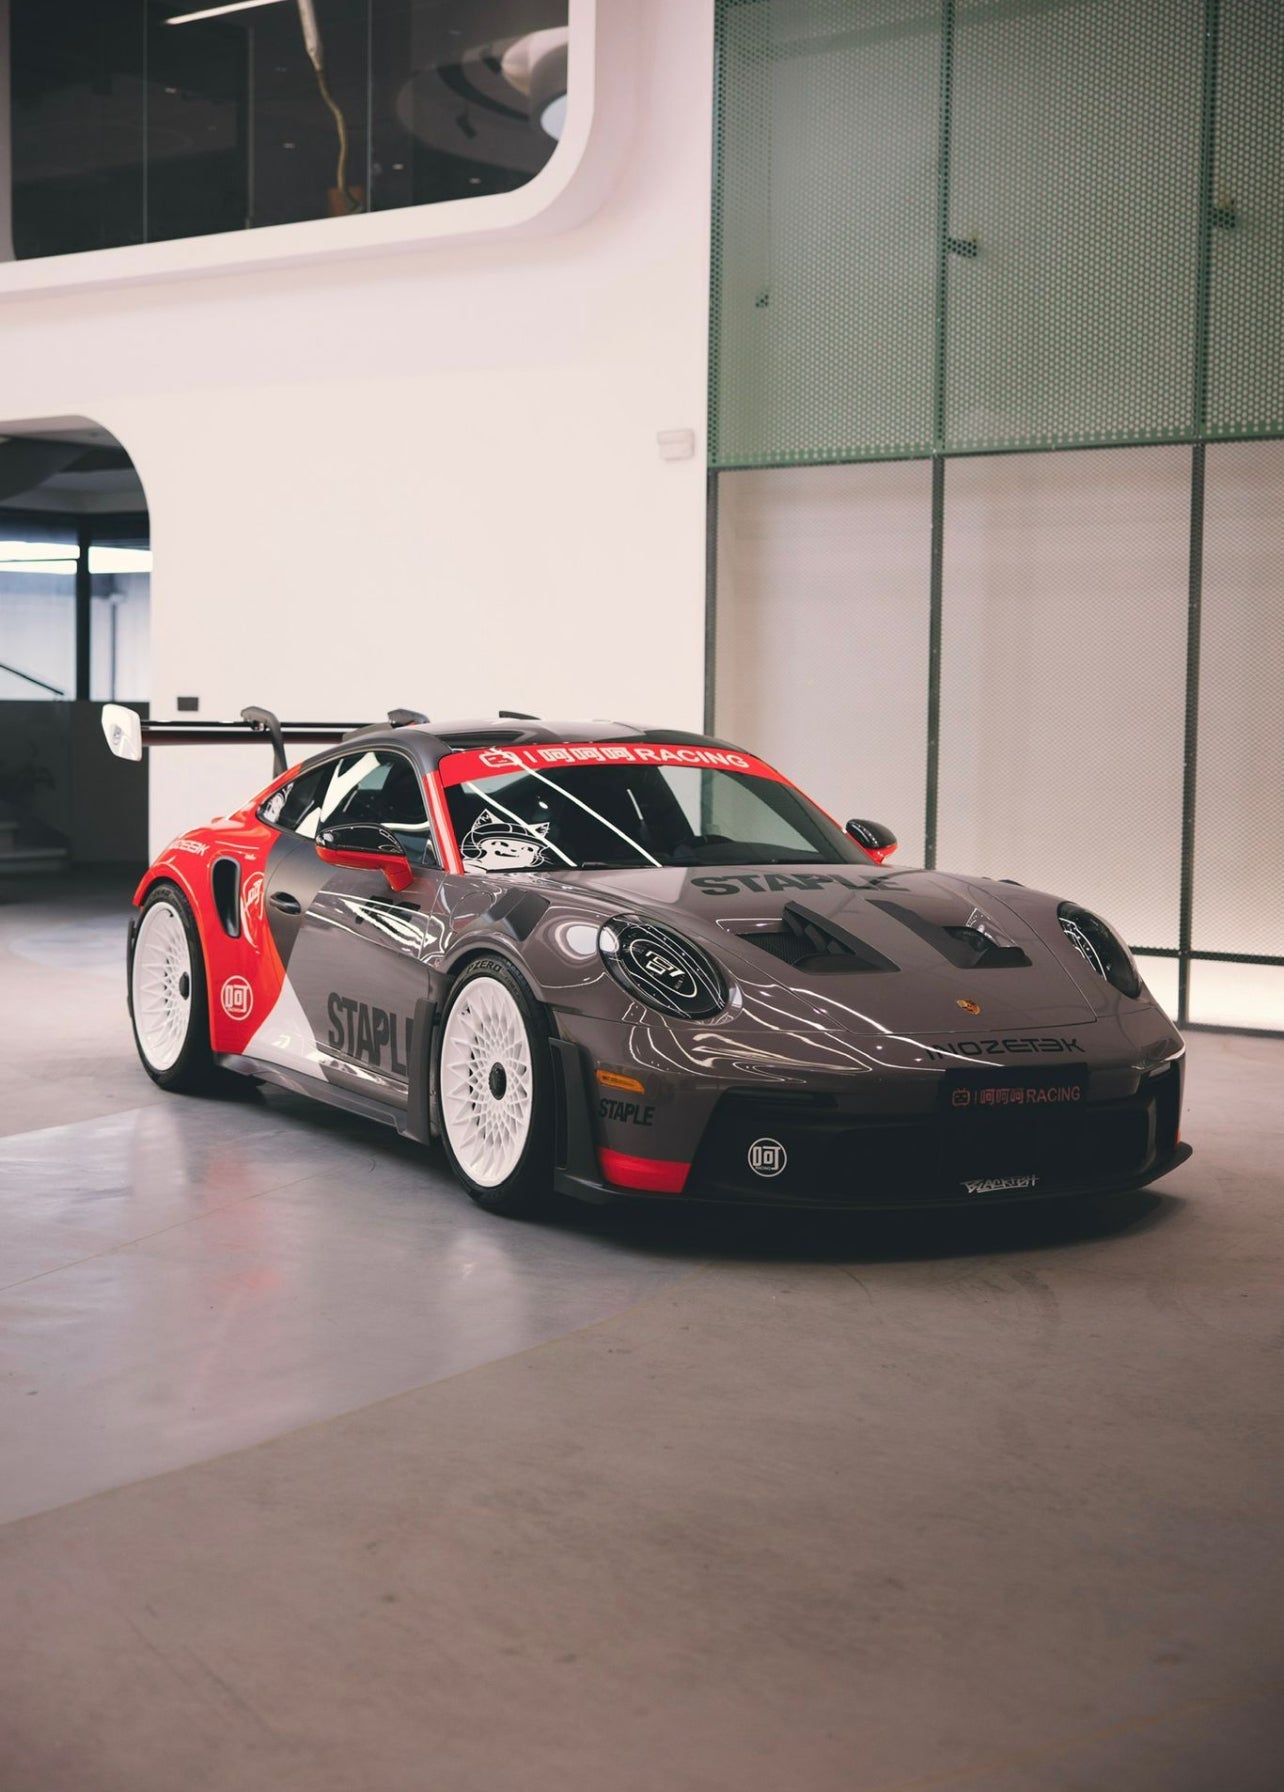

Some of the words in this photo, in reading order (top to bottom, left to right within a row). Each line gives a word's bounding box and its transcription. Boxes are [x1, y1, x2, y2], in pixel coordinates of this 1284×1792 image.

[633, 747, 750, 769] RACING
[1026, 1086, 1081, 1104] RACING
[600, 1098, 656, 1127] STAPLE
